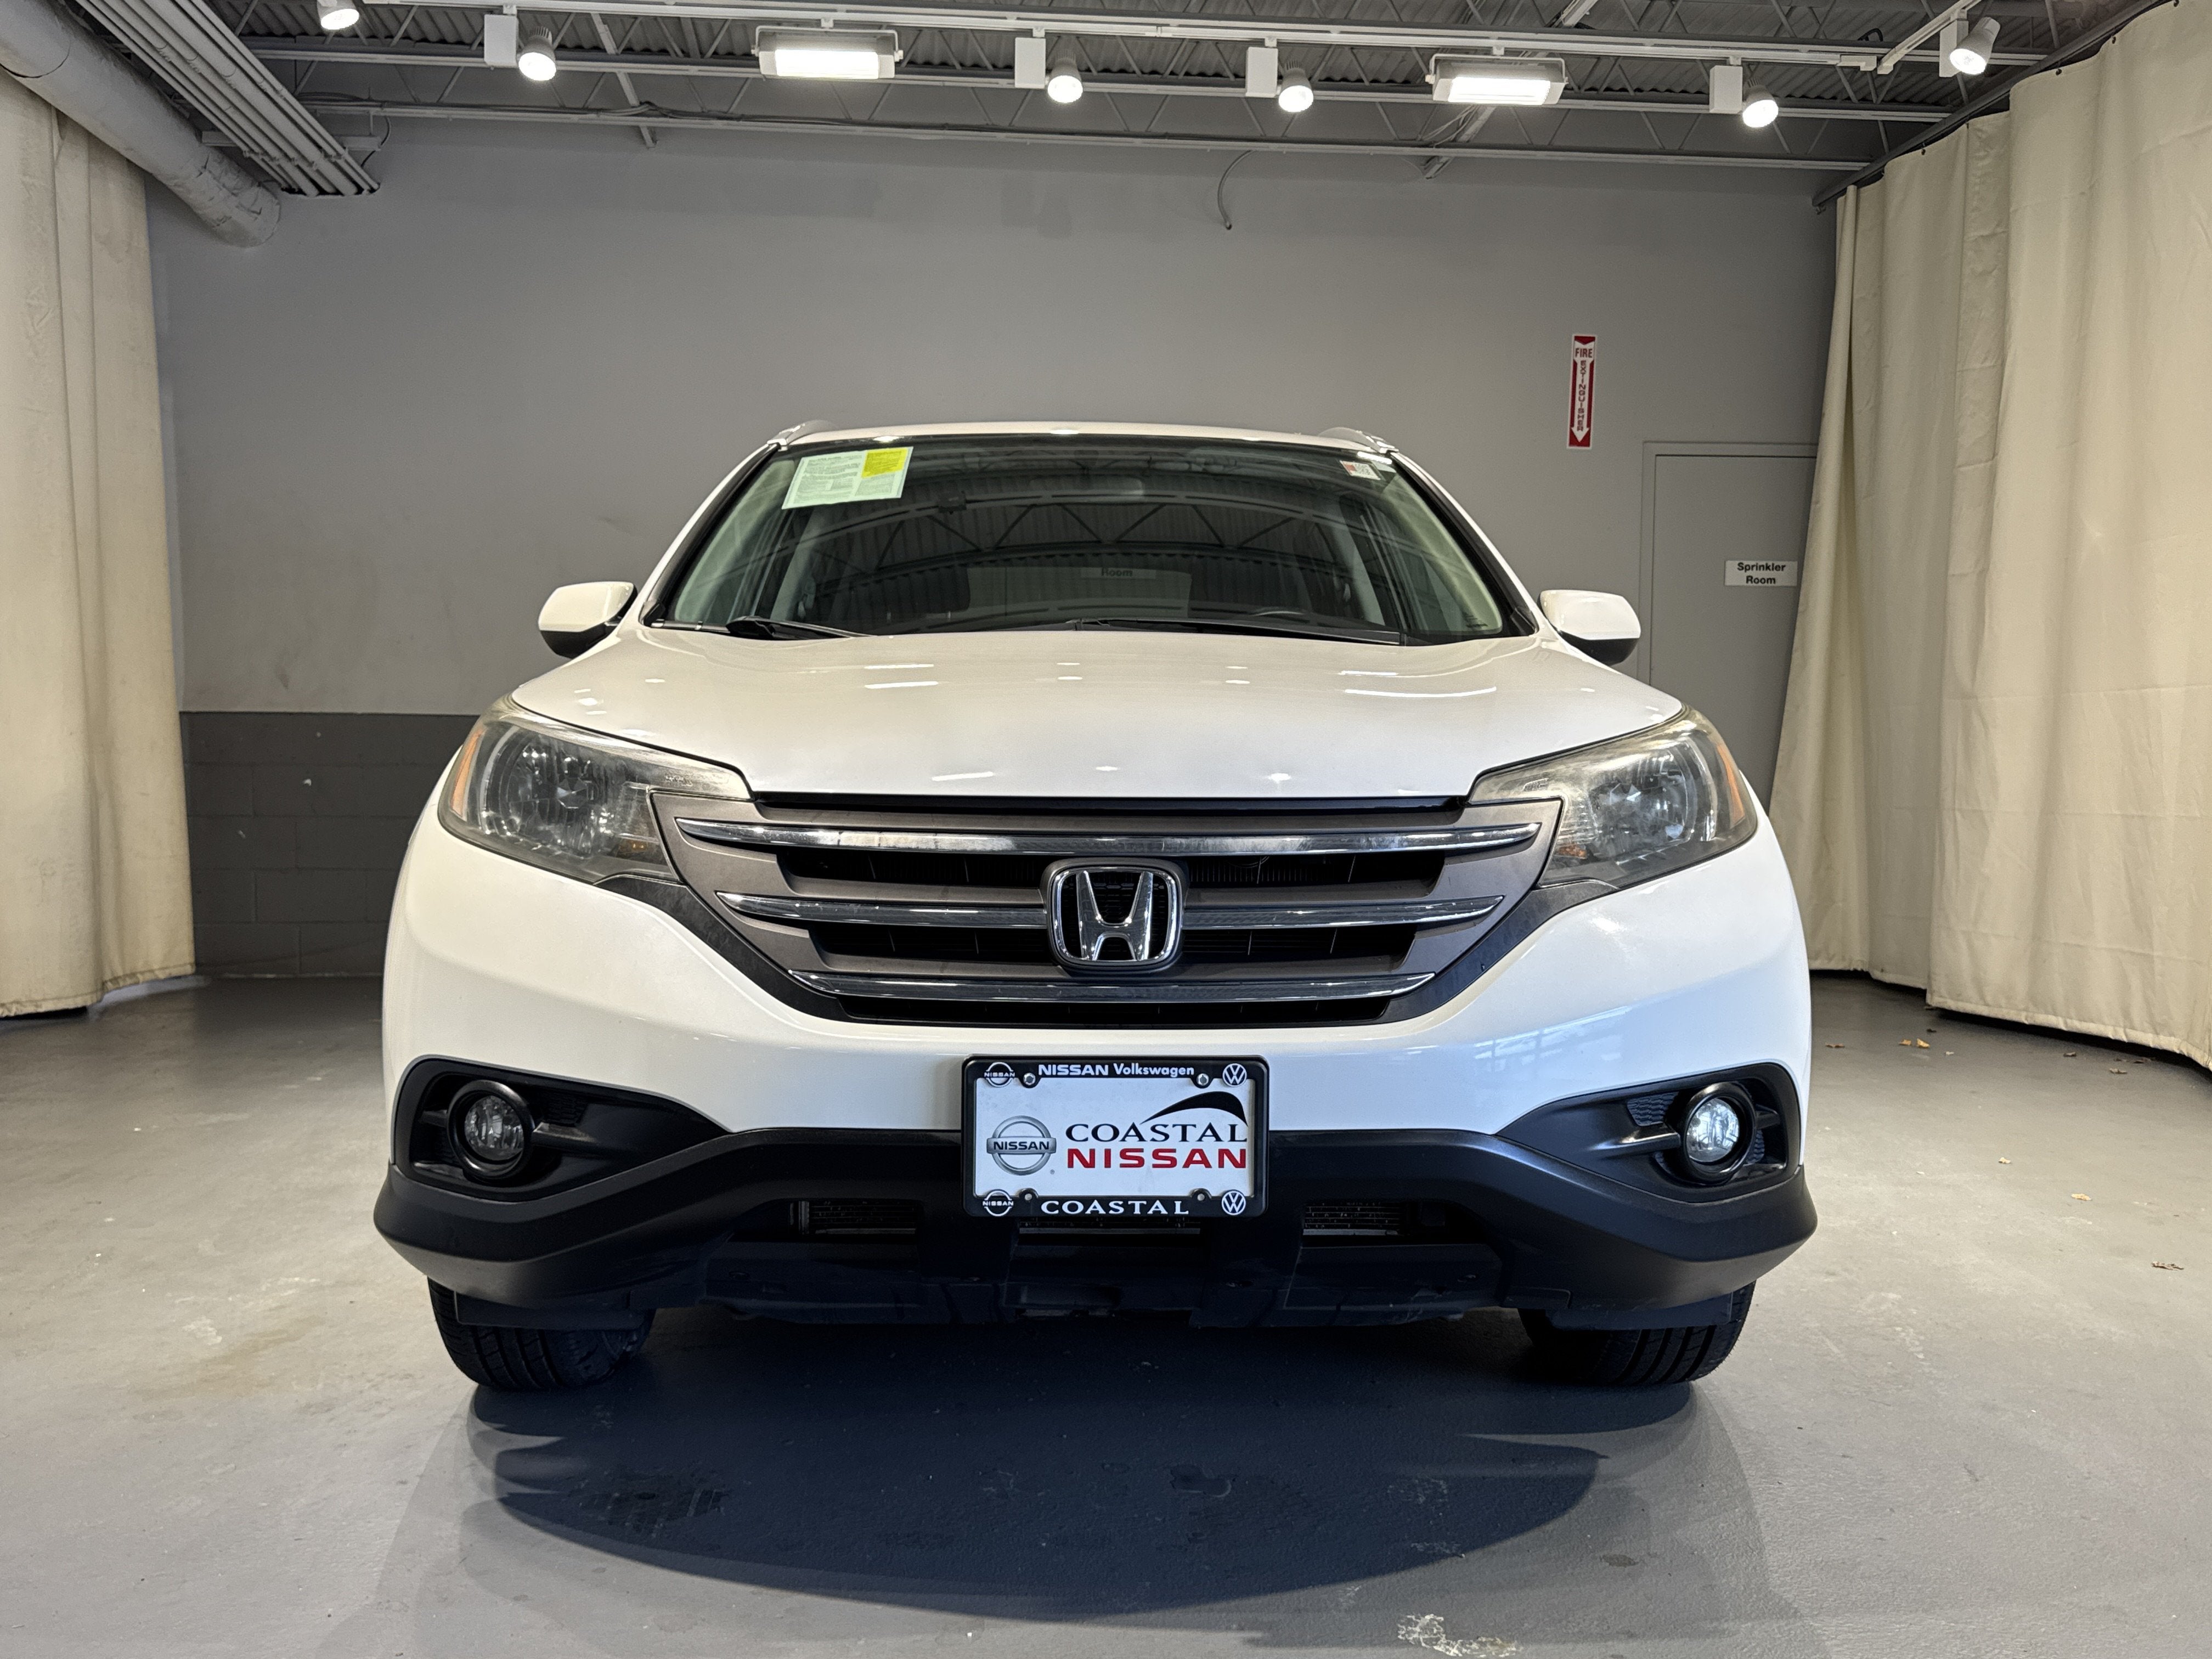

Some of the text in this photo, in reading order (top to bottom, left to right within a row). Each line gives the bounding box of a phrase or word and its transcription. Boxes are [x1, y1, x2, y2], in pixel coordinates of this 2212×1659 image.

[1575, 348, 1593, 358] FIRE
[1577, 360, 1587, 432] EXTINGUISHER
[1737, 562, 1786, 573] Sprinkler
[1746, 575, 1776, 584] Room
[1039, 1063, 1194, 1077] NISSAN Volkswagen
[1065, 1122, 1248, 1143] COASTAL
[993, 1141, 1049, 1150] NISSAN
[1067, 1148, 1246, 1169] NISSAN
[1041, 1200, 1189, 1214] COASTAL
